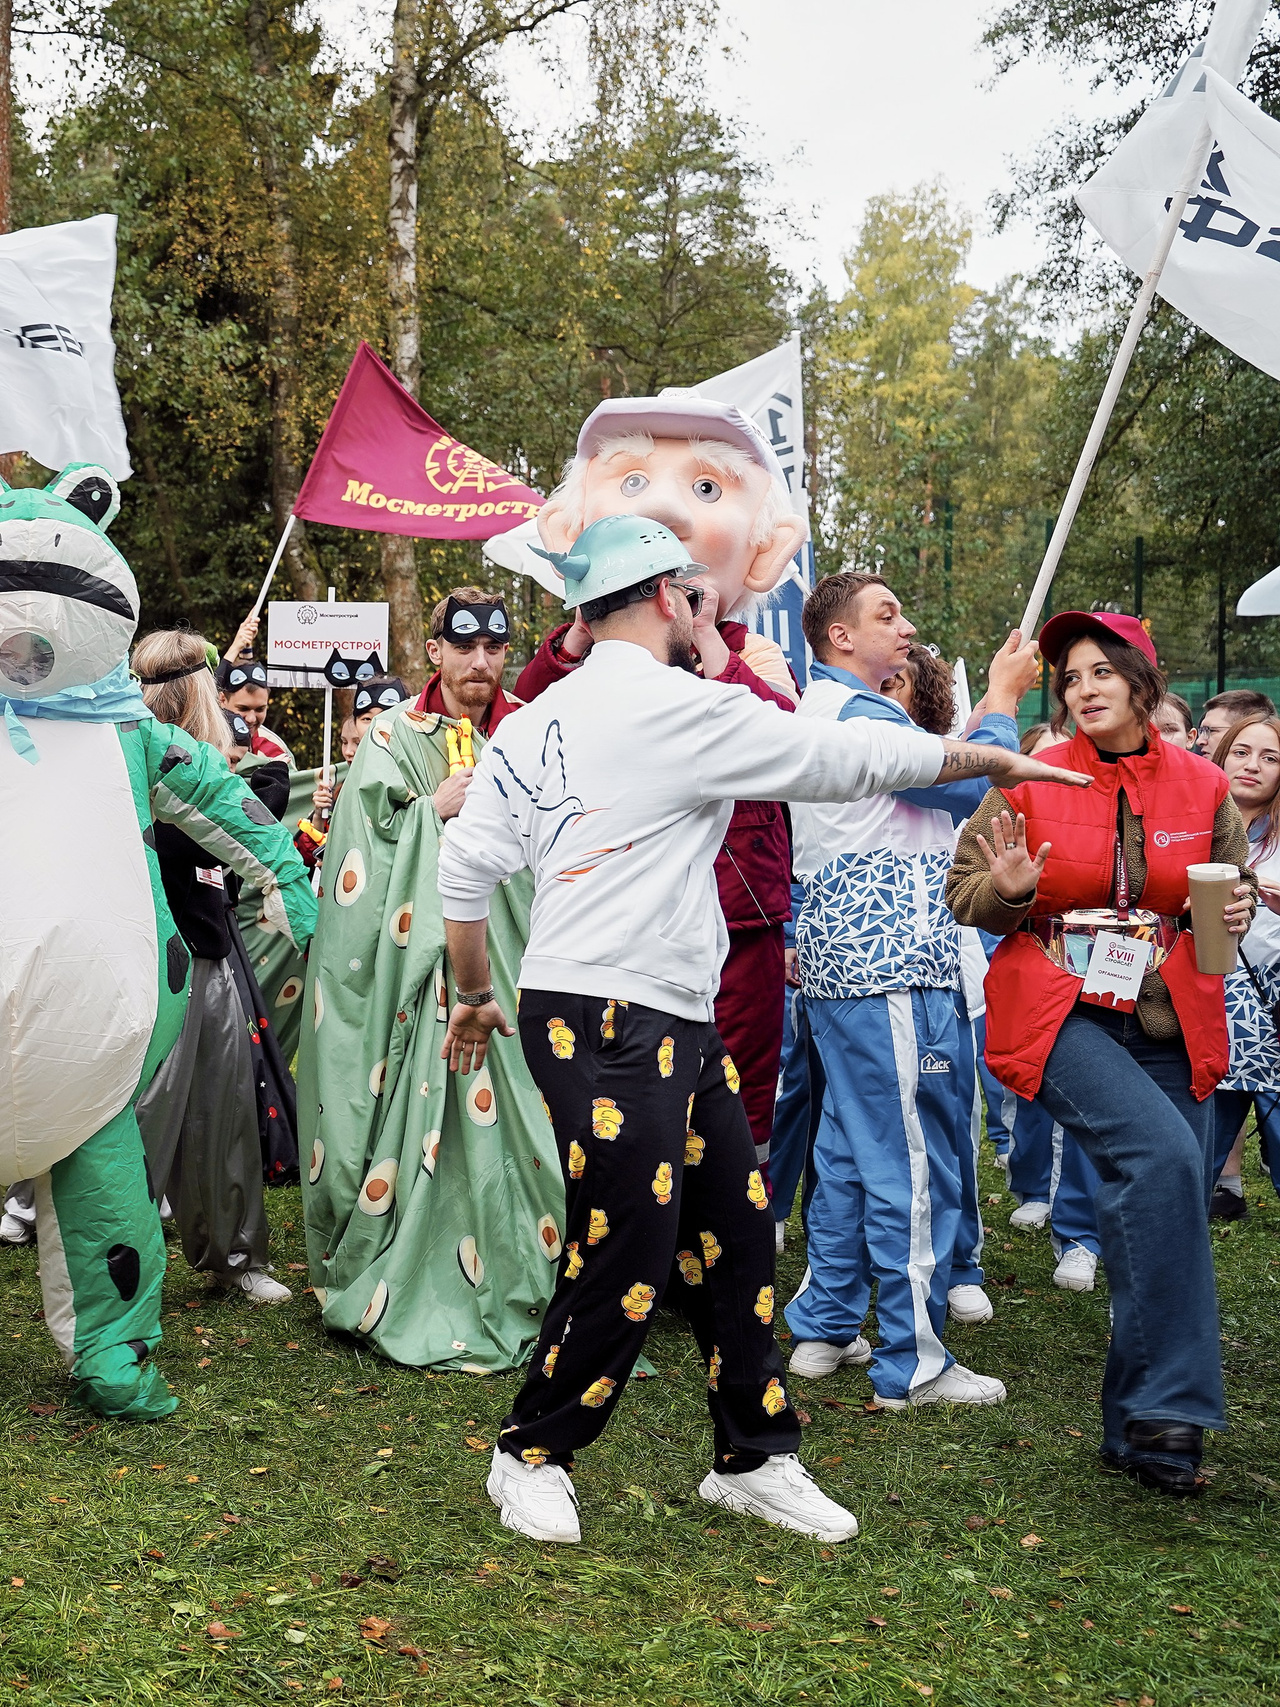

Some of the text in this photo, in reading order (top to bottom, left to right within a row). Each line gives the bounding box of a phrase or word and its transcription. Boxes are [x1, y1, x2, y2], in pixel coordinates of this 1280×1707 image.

[341, 479, 542, 522] Мосметростр
[274, 639, 381, 651] МОСМЕТРОСТРОЙ
[1107, 948, 1135, 963] XVIII
[1097, 969, 1132, 982] ОРГАНИЗАТОР
